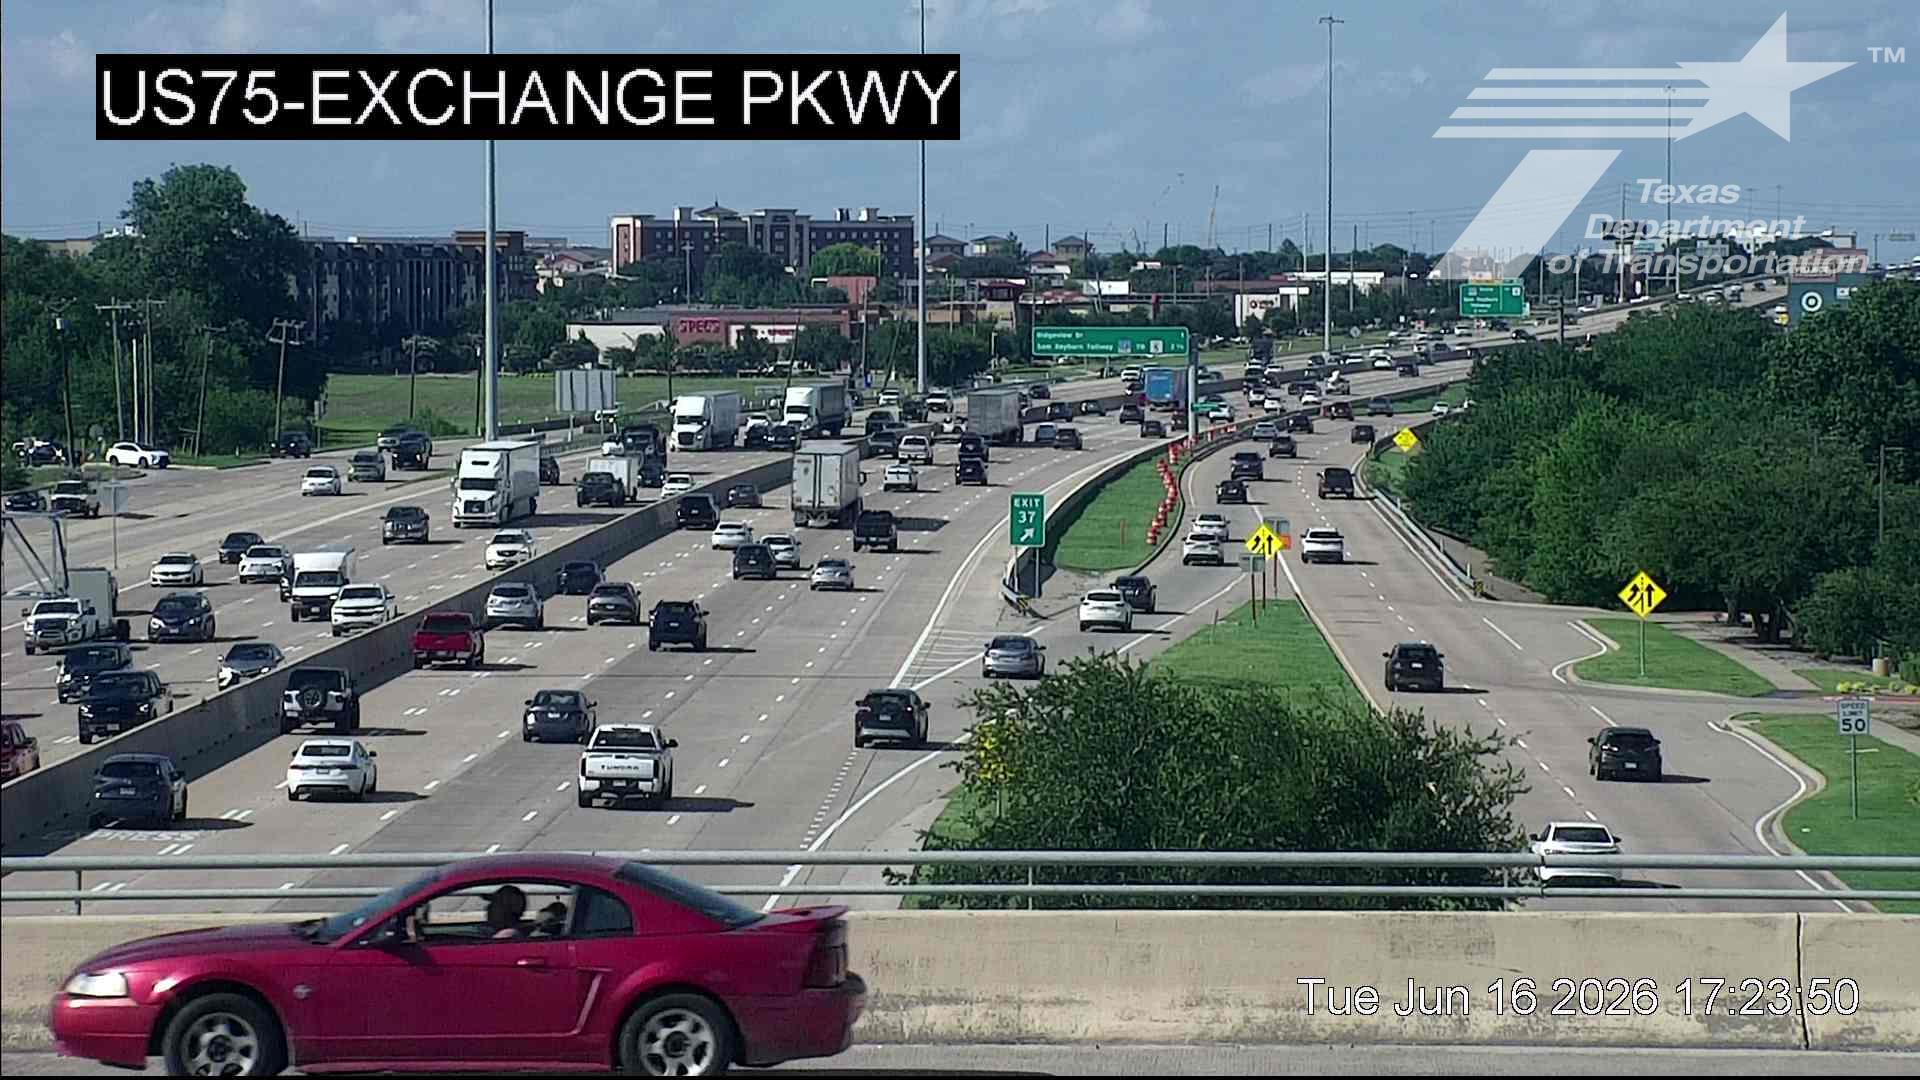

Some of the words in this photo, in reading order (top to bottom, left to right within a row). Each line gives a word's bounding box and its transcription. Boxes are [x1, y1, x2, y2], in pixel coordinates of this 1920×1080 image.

[1013, 497, 1041, 508] EXIT
[1017, 510, 1036, 524] 37
[1841, 718, 1866, 732] 50
